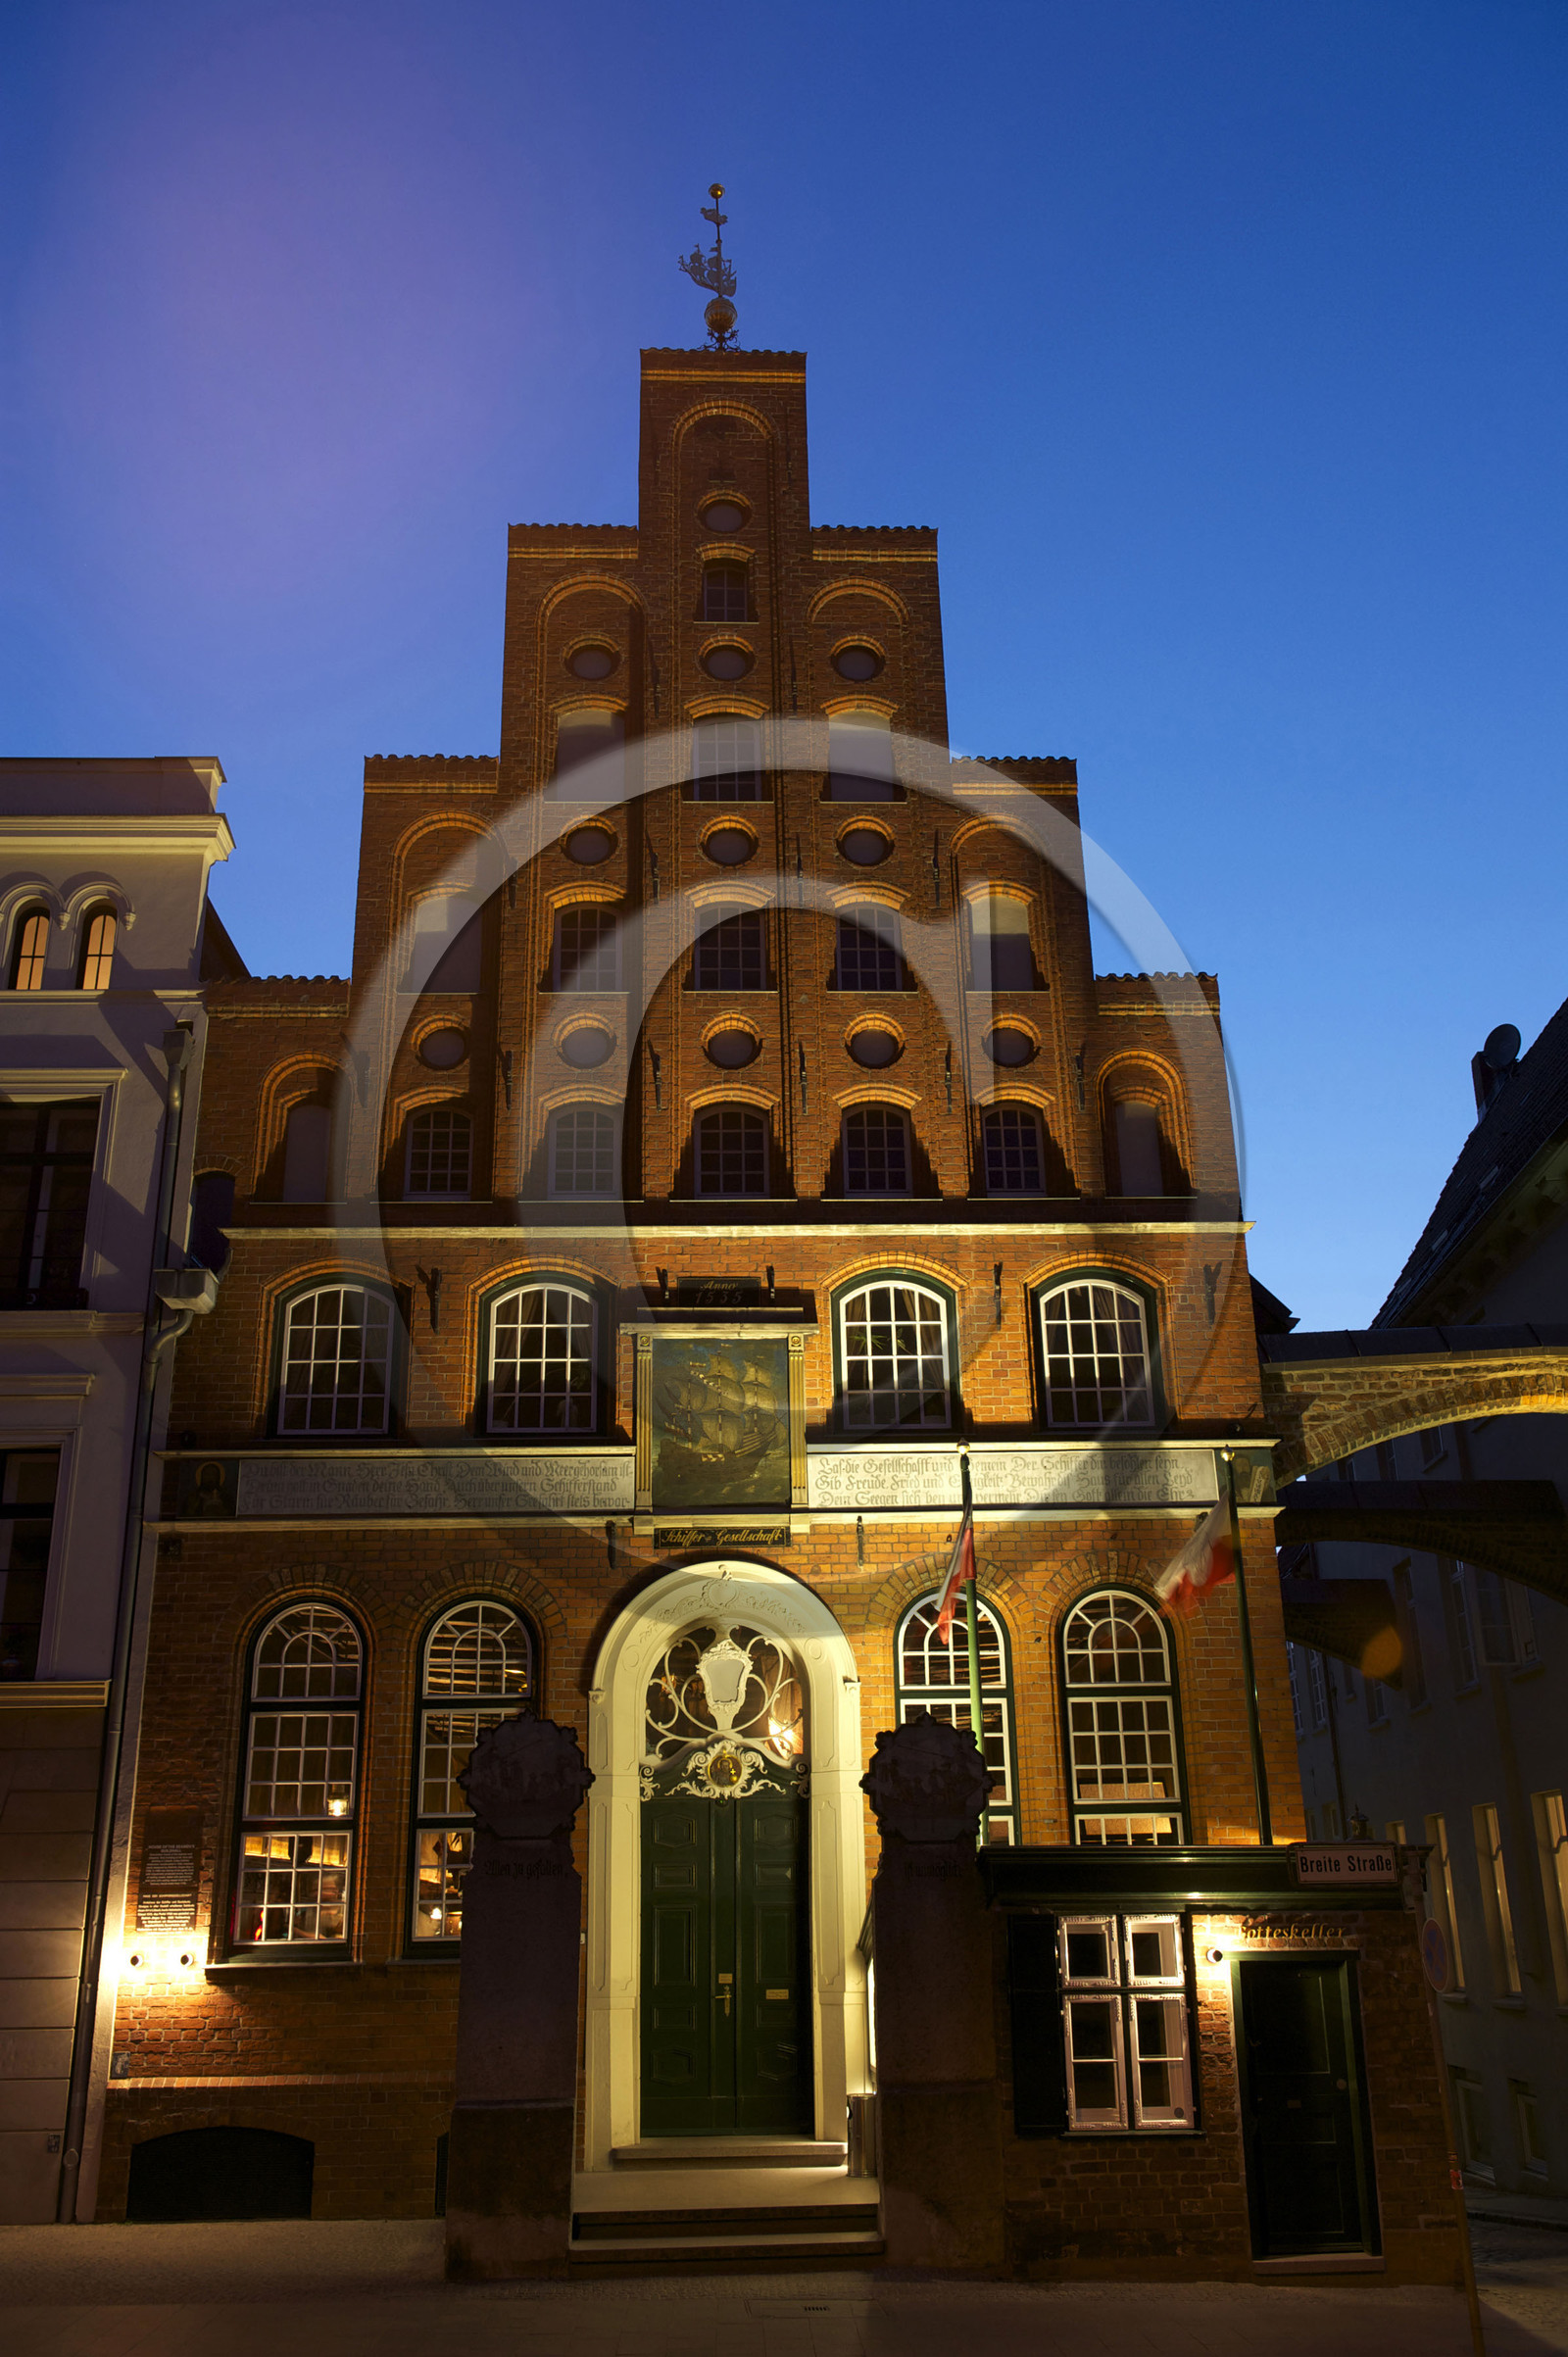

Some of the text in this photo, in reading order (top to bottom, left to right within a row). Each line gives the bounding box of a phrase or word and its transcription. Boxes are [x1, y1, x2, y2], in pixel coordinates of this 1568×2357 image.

[700, 1280, 739, 1291] Anno
[695, 1291, 744, 1304] 1535
[521, 1459, 542, 1477] und
[932, 1456, 954, 1472] und
[1041, 1454, 1089, 1473] Schiffer
[540, 1477, 619, 1495] Schifferstand
[815, 1474, 841, 1490] Gib
[922, 1472, 944, 1488] und
[567, 1494, 590, 1508] stets
[662, 1530, 706, 1547] Schiffer
[715, 1528, 783, 1546] Gesellschaft
[481, 1859, 511, 1876] Allen
[513, 1862, 523, 1881] zu
[1299, 1854, 1393, 1873] Breite Straße
